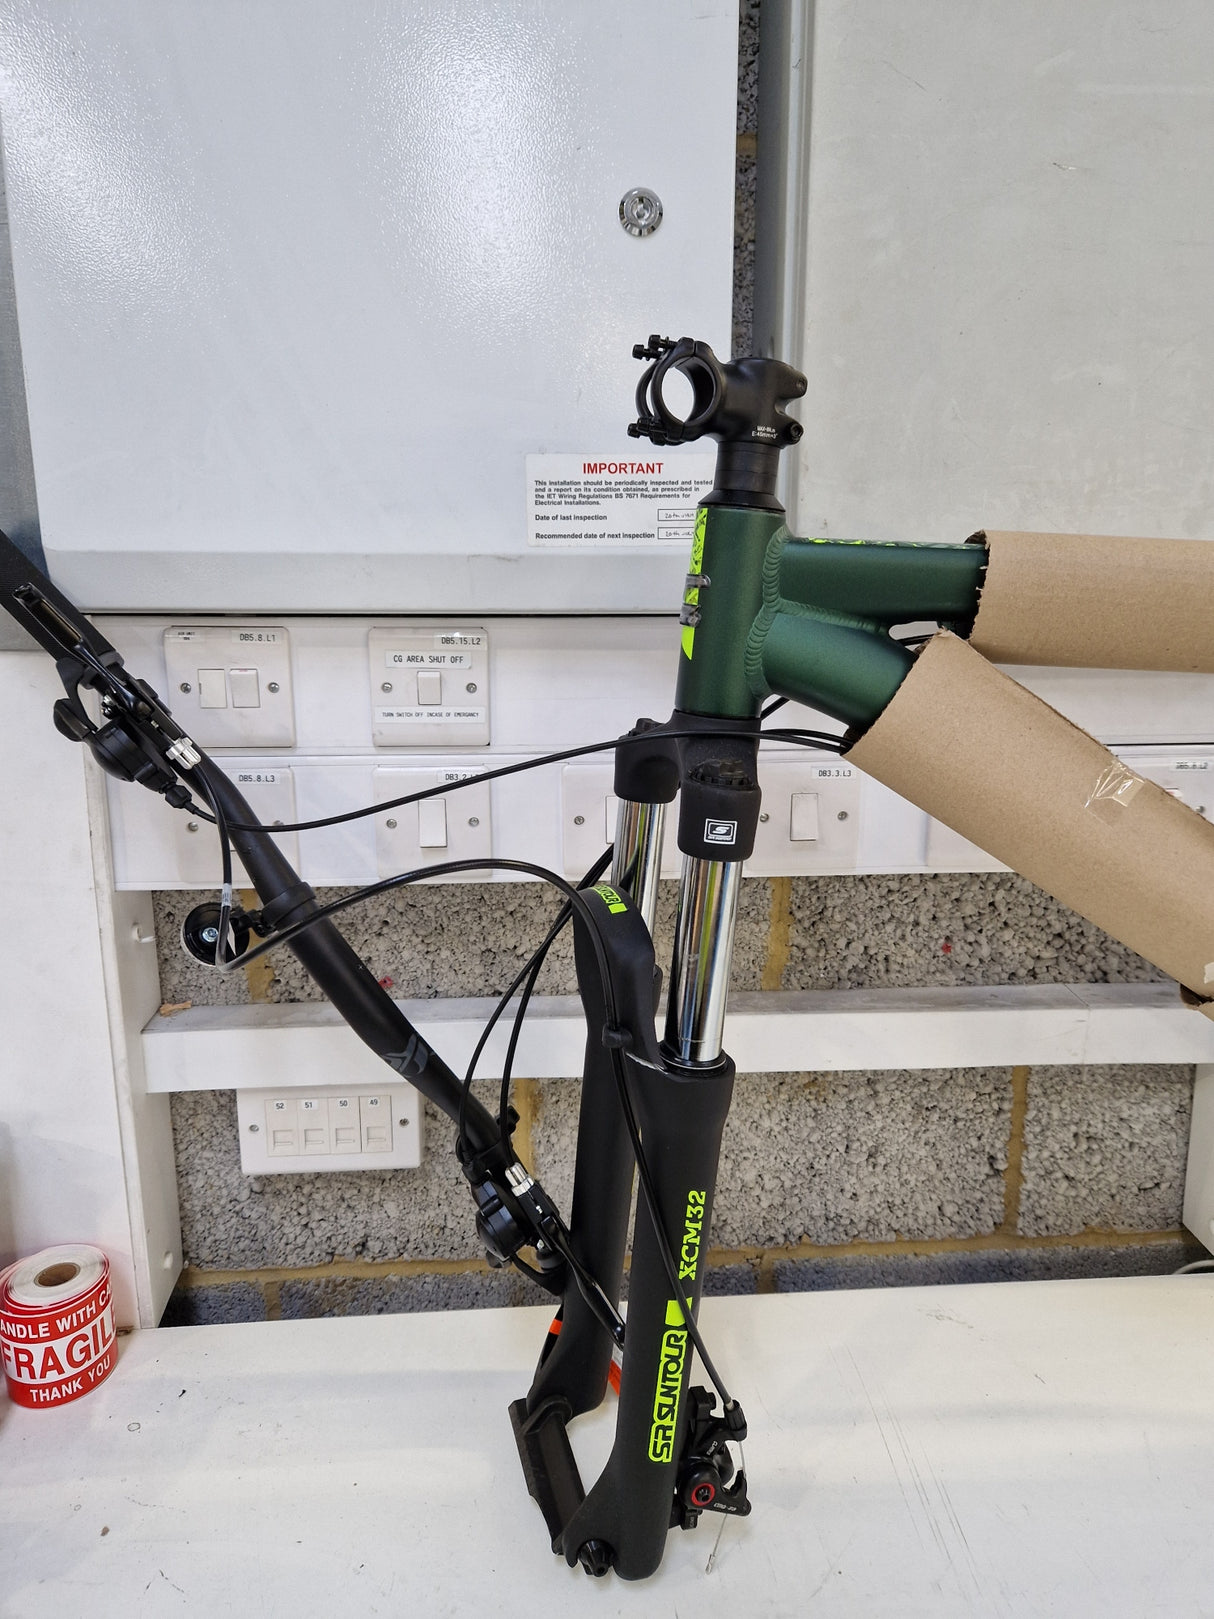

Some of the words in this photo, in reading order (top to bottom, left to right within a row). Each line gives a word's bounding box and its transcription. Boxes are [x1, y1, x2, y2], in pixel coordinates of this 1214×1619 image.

[582, 462, 664, 474] IMPORTANT
[240, 633, 276, 642] DB5.8.L1
[442, 637, 480, 645] DB5.15.L2
[393, 655, 402, 663] CG
[406, 655, 424, 663] AREA
[239, 774, 275, 782] DB5.8.L3
[678, 1190, 706, 1280] XCM32
[0, 1319, 50, 1339] ANDLE
[56, 1303, 96, 1333] WITH
[99, 1283, 111, 1306] CA
[2, 1310, 115, 1380] FRAGIL
[30, 1378, 83, 1402] THANK
[88, 1354, 110, 1383] YOU
[656, 1333, 685, 1422] SUNTOUR
